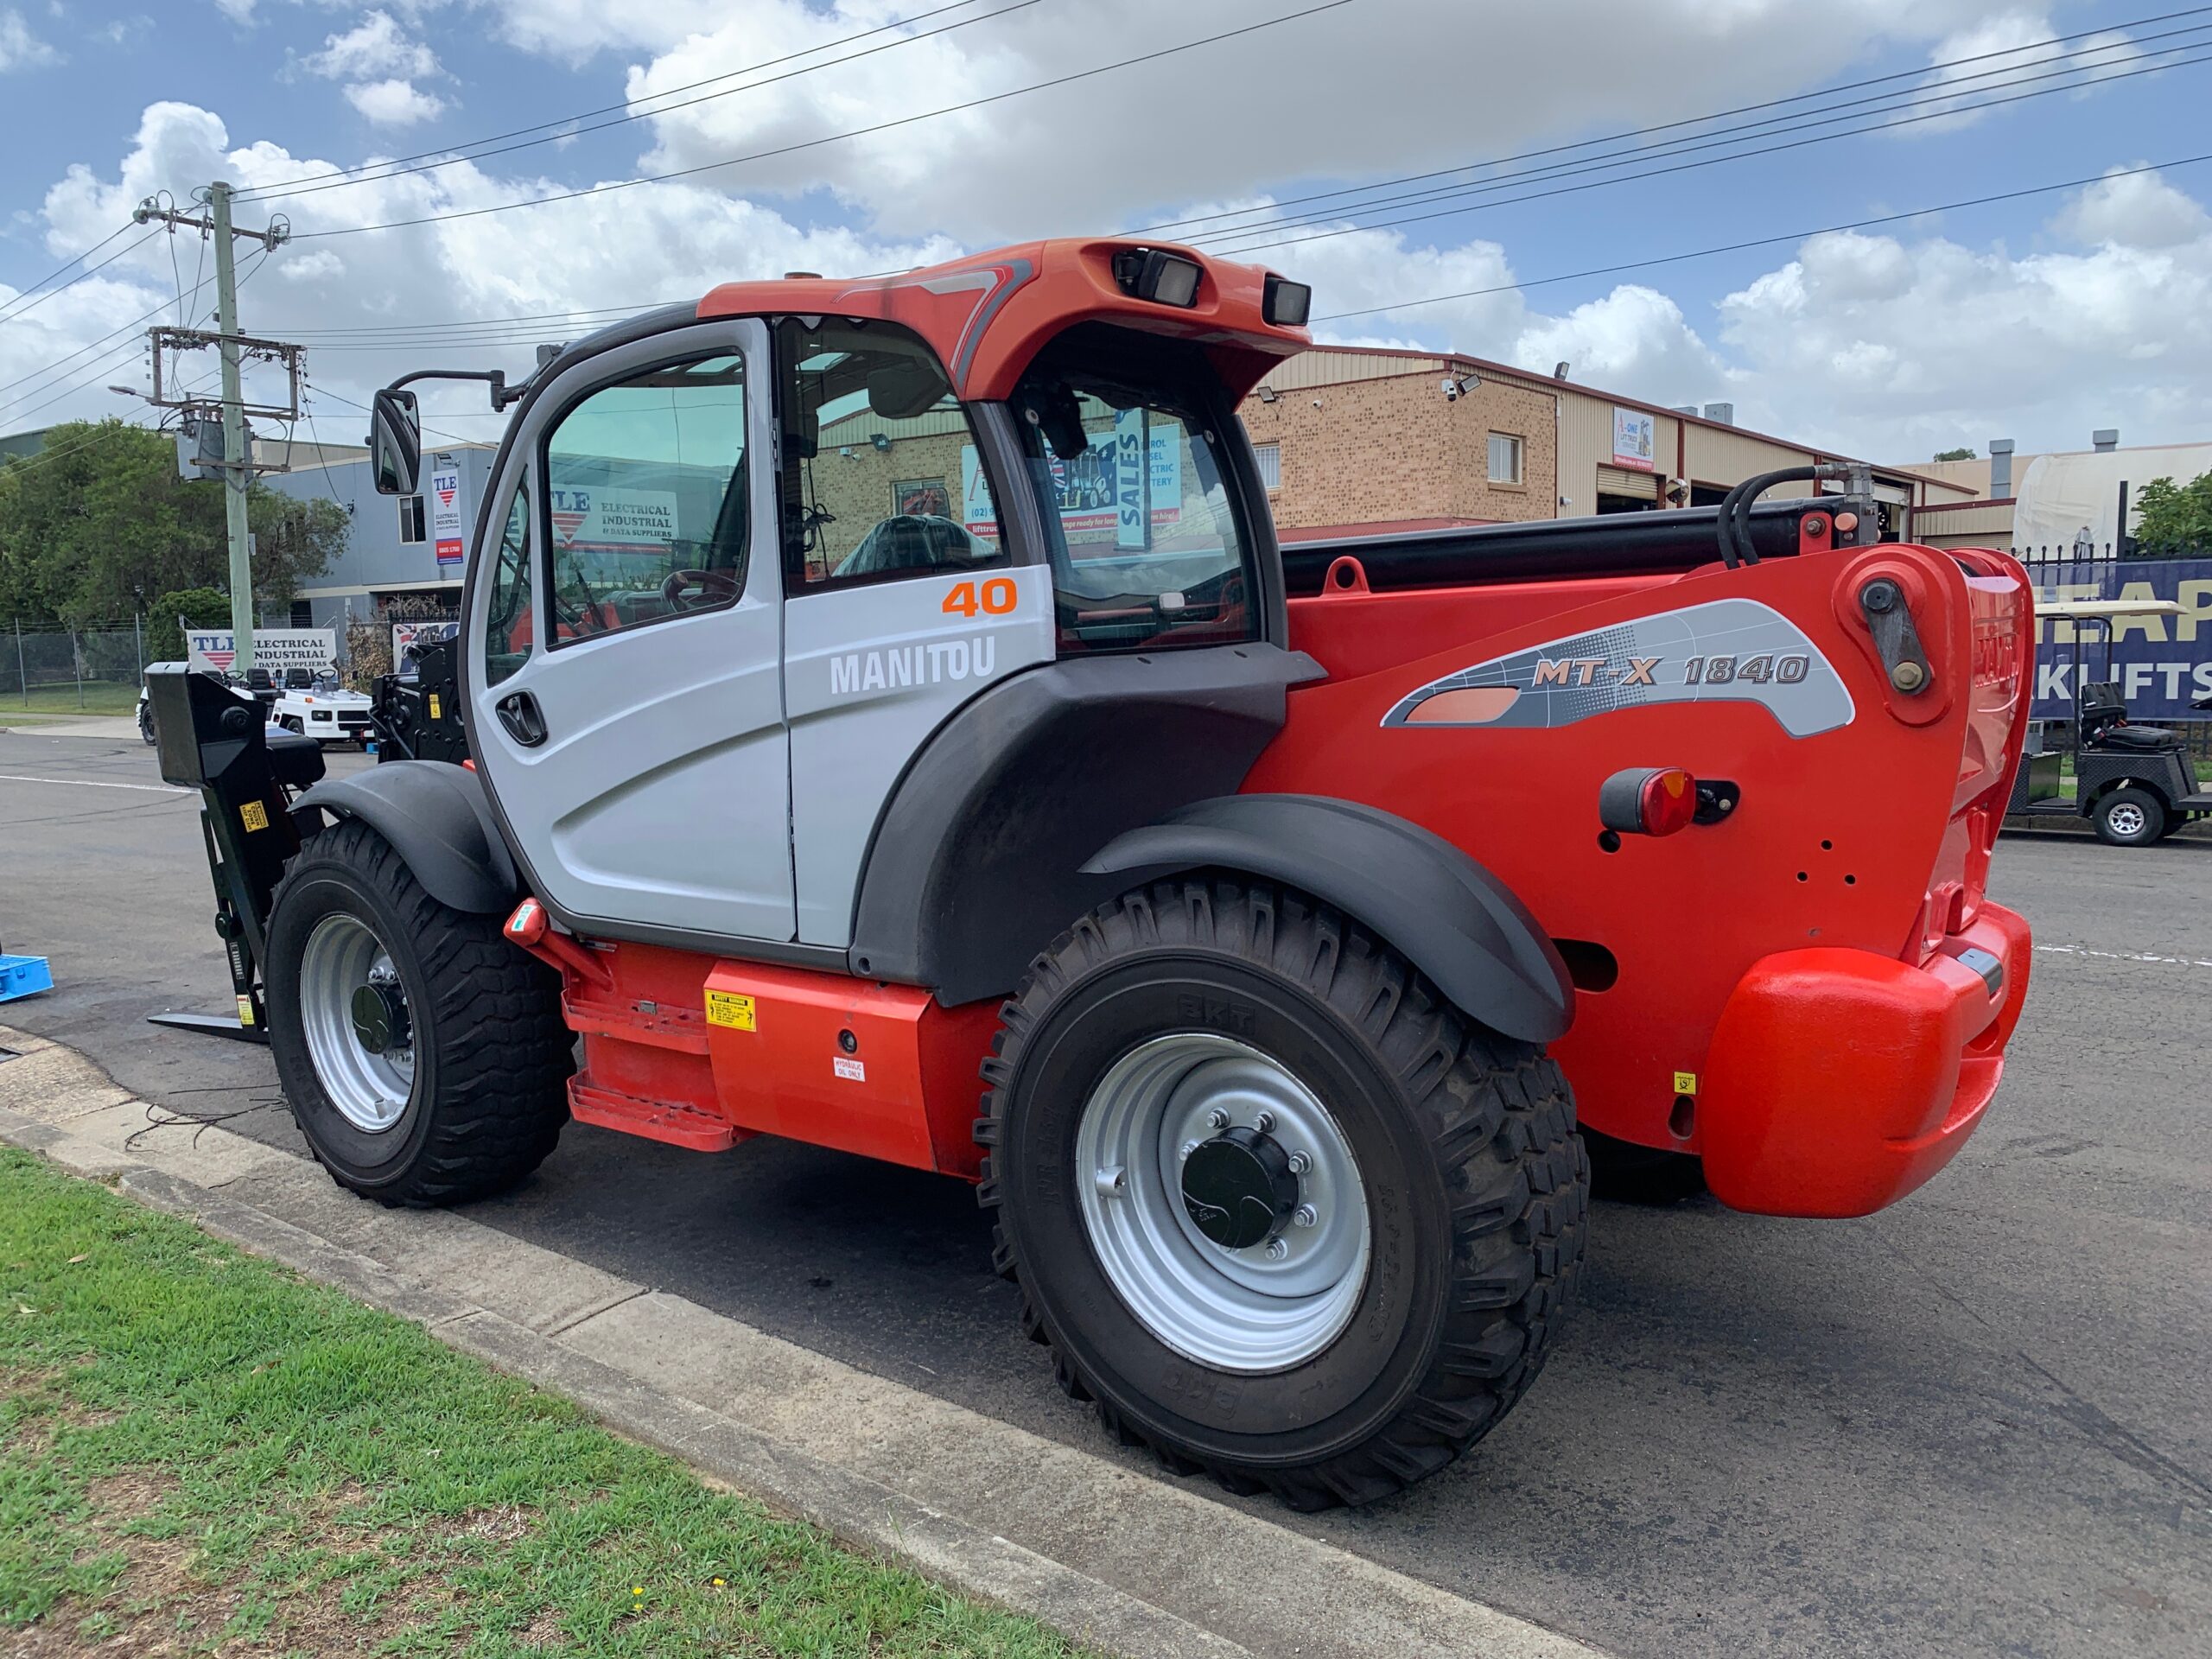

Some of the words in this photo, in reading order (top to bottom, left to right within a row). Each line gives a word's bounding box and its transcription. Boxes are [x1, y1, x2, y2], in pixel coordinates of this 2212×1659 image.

[1150, 439, 1166, 448] ROL
[1149, 452, 1163, 461] SEL
[1150, 463, 1174, 474] CTRIC
[434, 476, 457, 491] TLE
[1120, 434, 1140, 526] SALES
[1152, 477, 1172, 486] TERY
[601, 503, 671, 516] ELECTRICAL
[971, 507, 988, 518] (02)
[602, 516, 672, 528] INDUSTRIAL
[1076, 518, 1094, 527] ready
[941, 577, 1018, 618] 40
[193, 637, 234, 652] TL
[254, 650, 327, 659] NDUSTRIAL
[830, 635, 995, 695] MANITOU
[1531, 655, 1664, 687] MT-X
[1684, 655, 1811, 685] 1840
[836, 1059, 861, 1071] HYDRAULIC
[849, 1070, 861, 1078] ONLY
